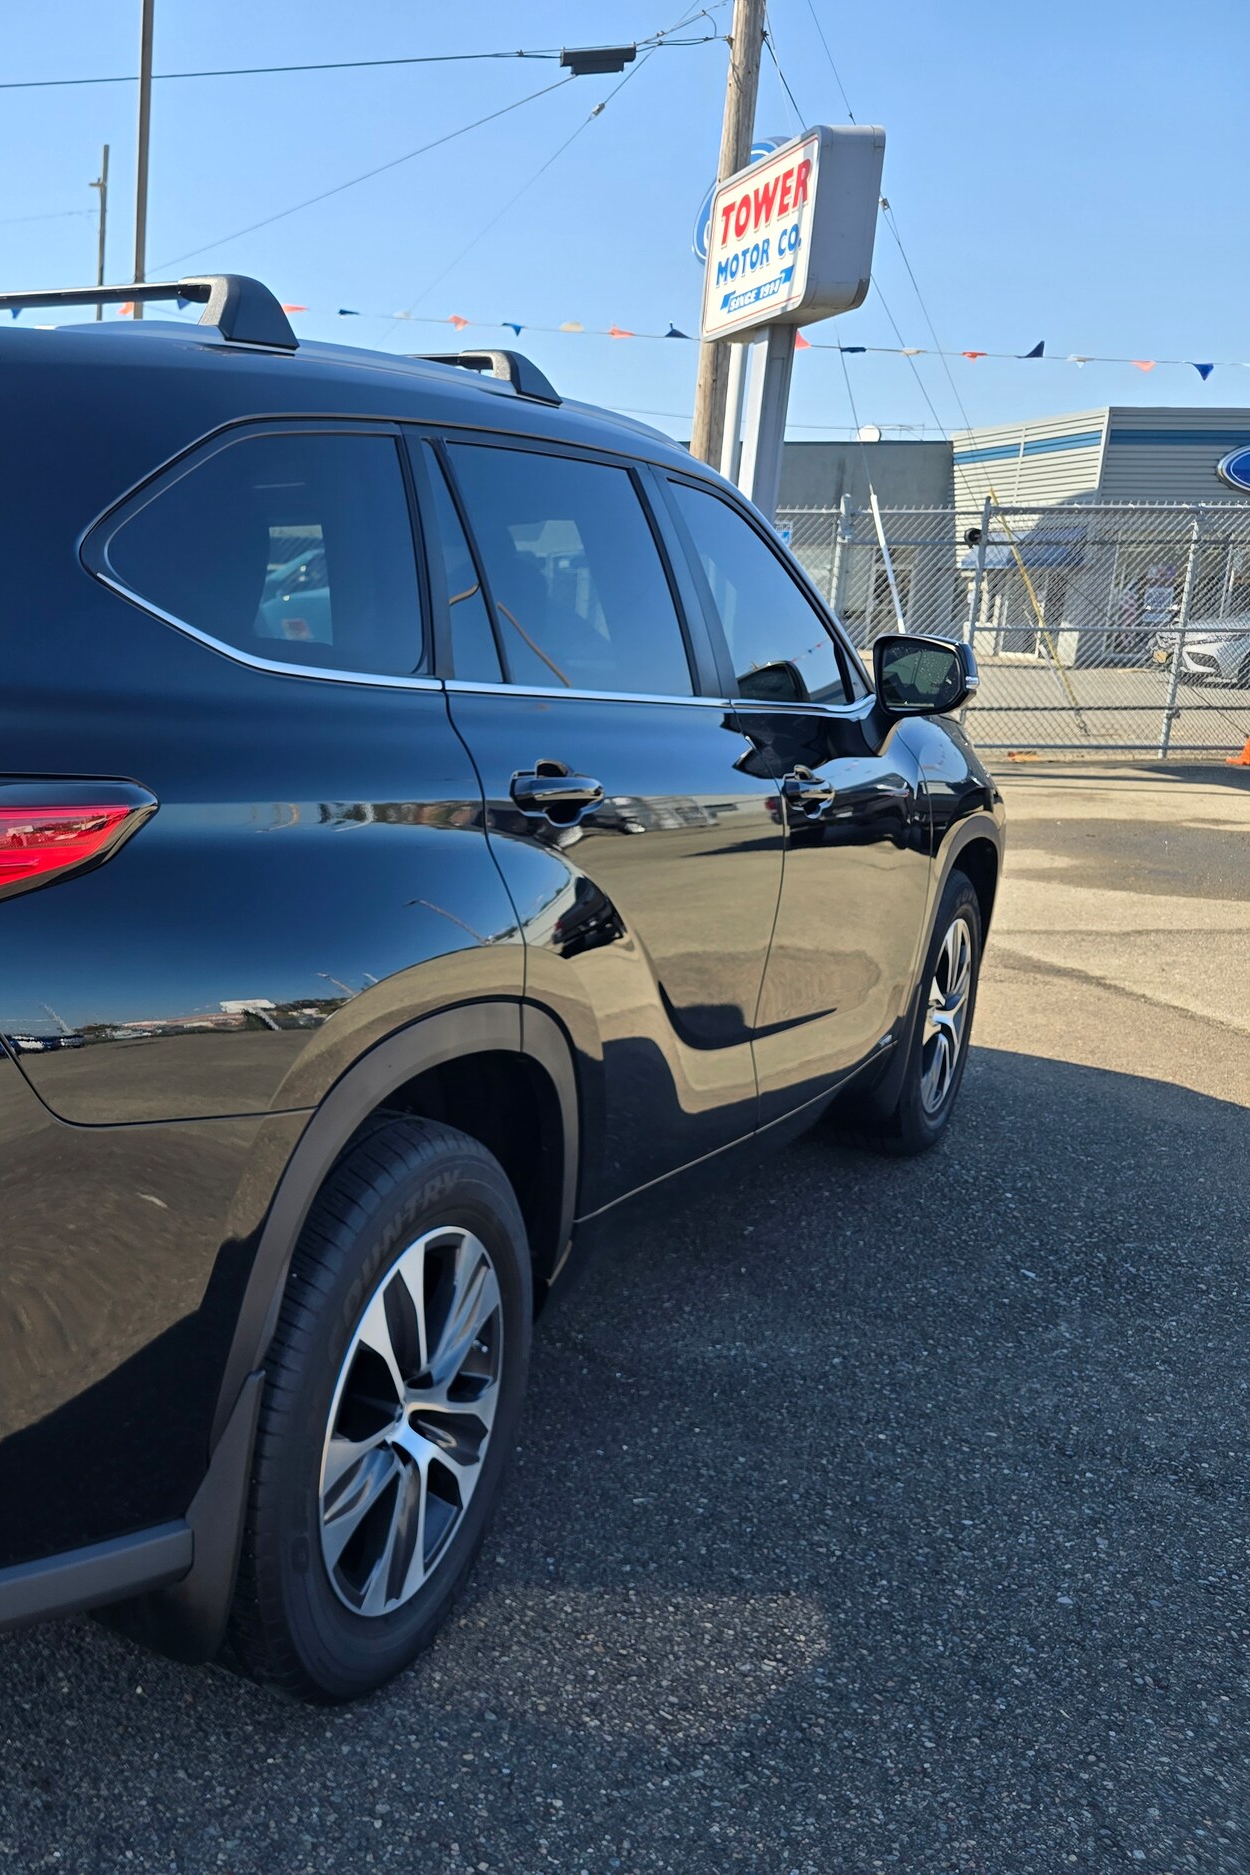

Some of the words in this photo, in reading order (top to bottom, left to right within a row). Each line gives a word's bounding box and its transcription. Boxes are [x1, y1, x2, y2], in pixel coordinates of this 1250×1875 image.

[720, 158, 811, 246] TOWER
[716, 238, 770, 286] MOTOR
[778, 223, 802, 254] CO.
[730, 290, 757, 311] SINCE
